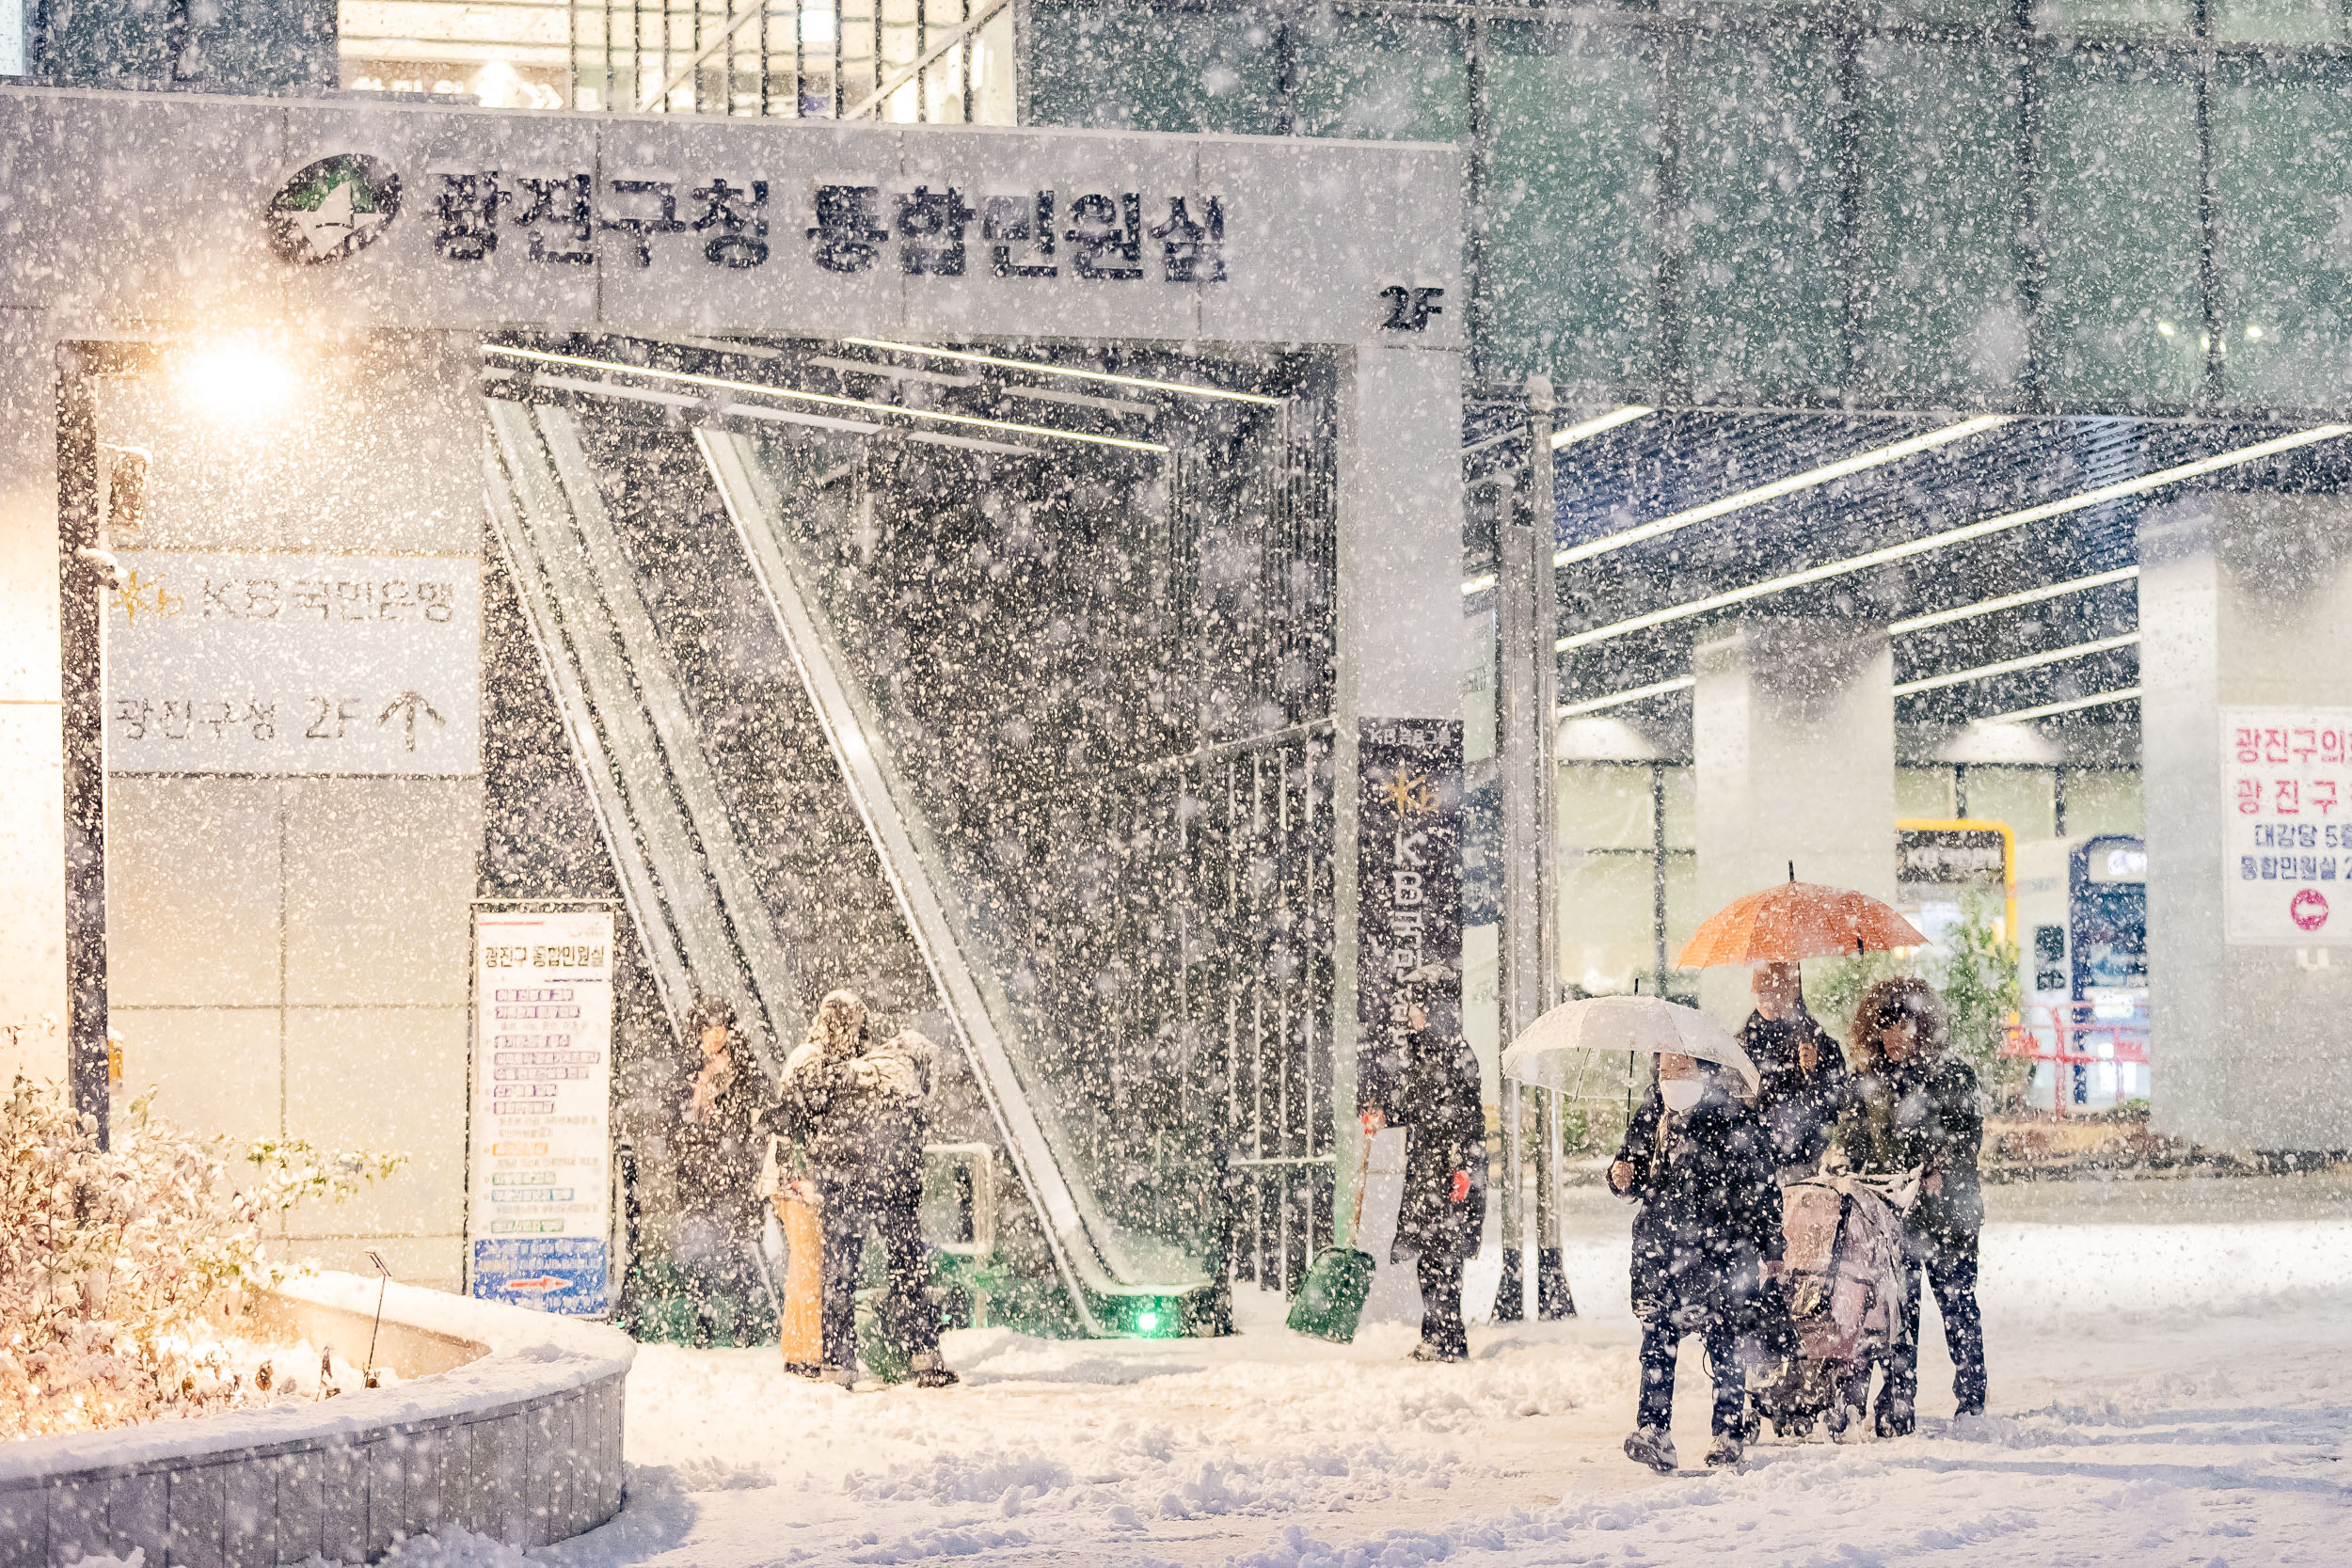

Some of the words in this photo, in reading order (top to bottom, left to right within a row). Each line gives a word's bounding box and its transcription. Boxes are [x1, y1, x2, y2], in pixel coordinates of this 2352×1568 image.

[426, 170, 771, 269] 광진구청
[806, 184, 1228, 283] 통합민원실
[1378, 284, 1445, 332] 2F
[305, 695, 362, 739] 2F
[2236, 727, 2352, 764] 광진구의
[2237, 779, 2352, 815] 광진구
[2241, 855, 2337, 880] 통합민원실
[485, 945, 528, 968] 광진구
